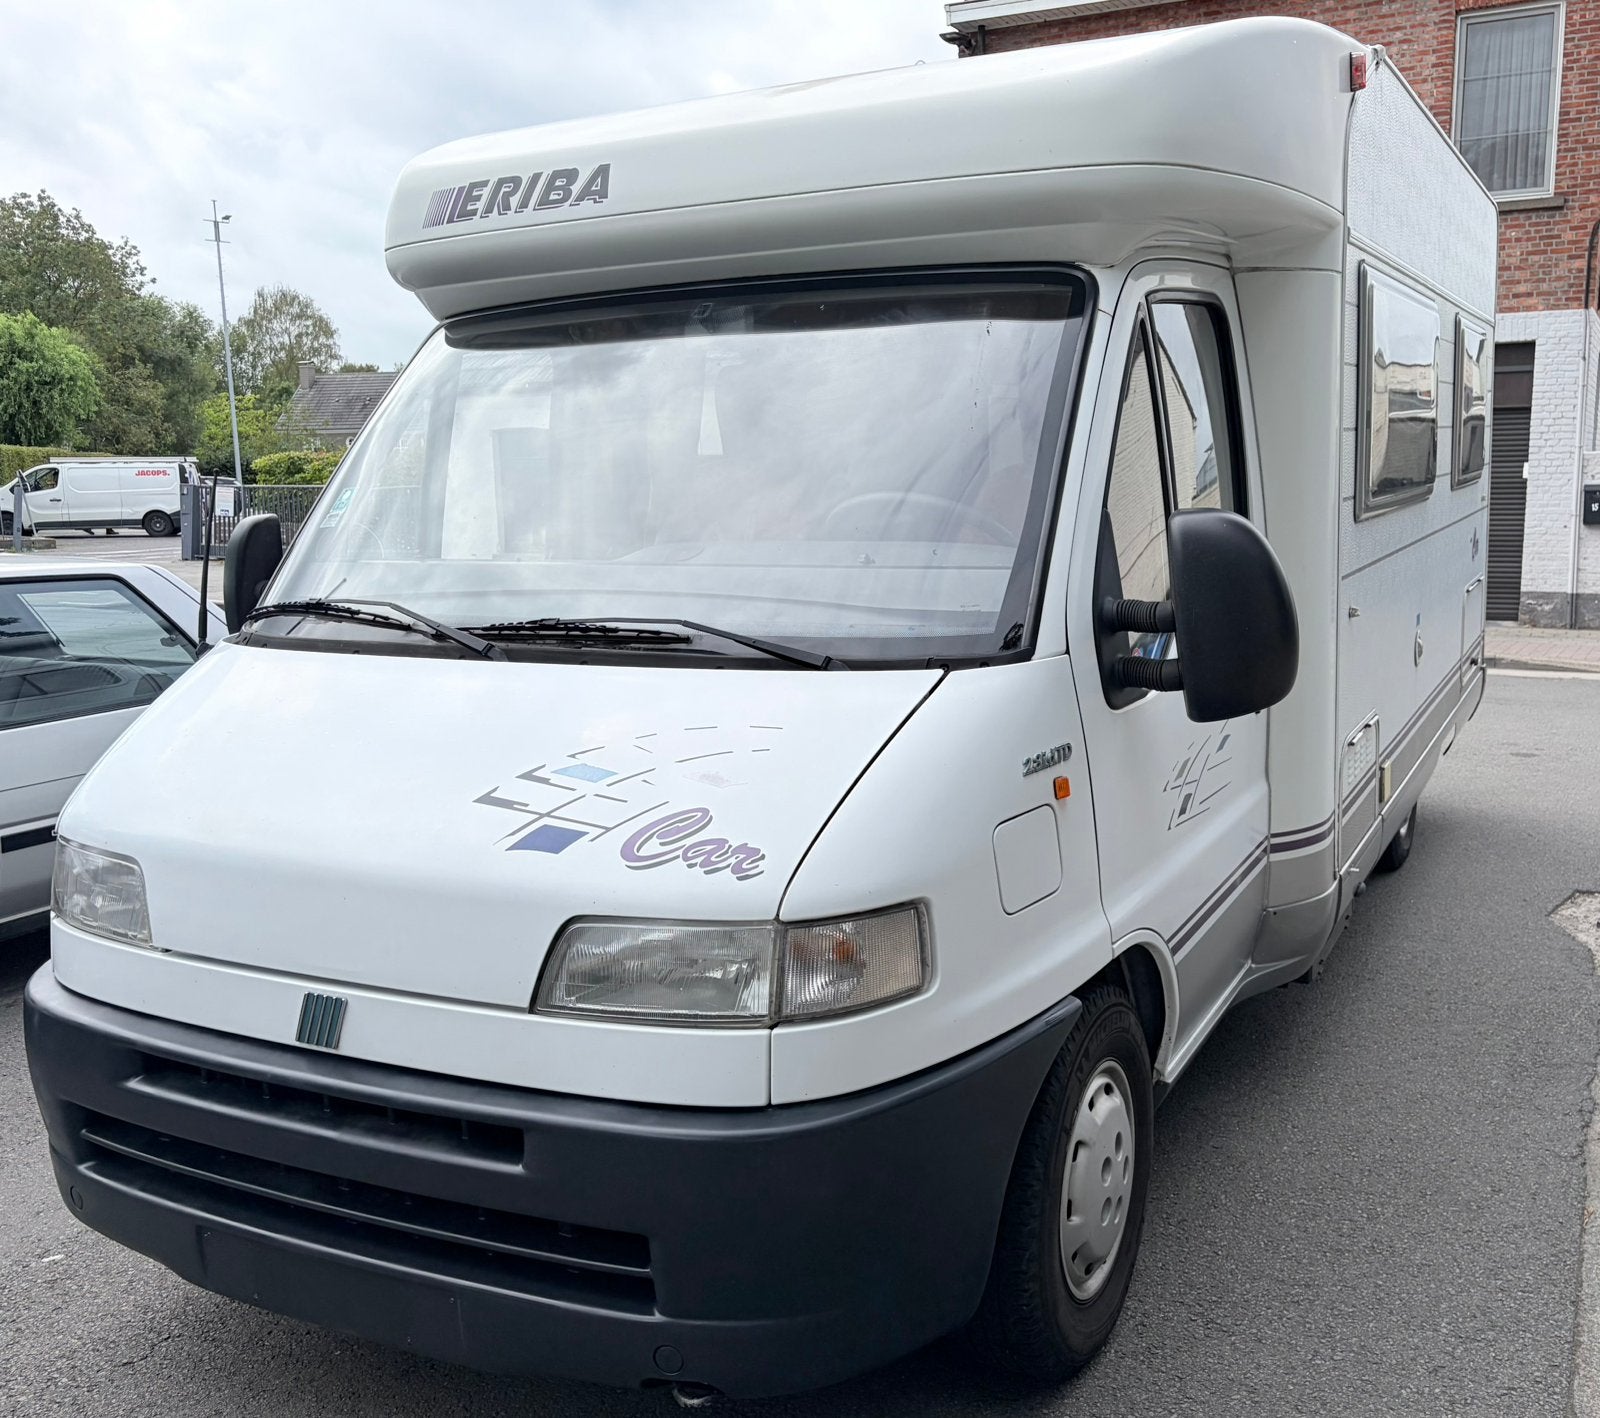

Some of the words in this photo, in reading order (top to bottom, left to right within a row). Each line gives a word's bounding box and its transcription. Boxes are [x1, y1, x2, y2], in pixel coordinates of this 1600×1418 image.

[446, 162, 612, 225] ERIBA
[1591, 503, 1599, 512] 15
[619, 806, 766, 882] Car
